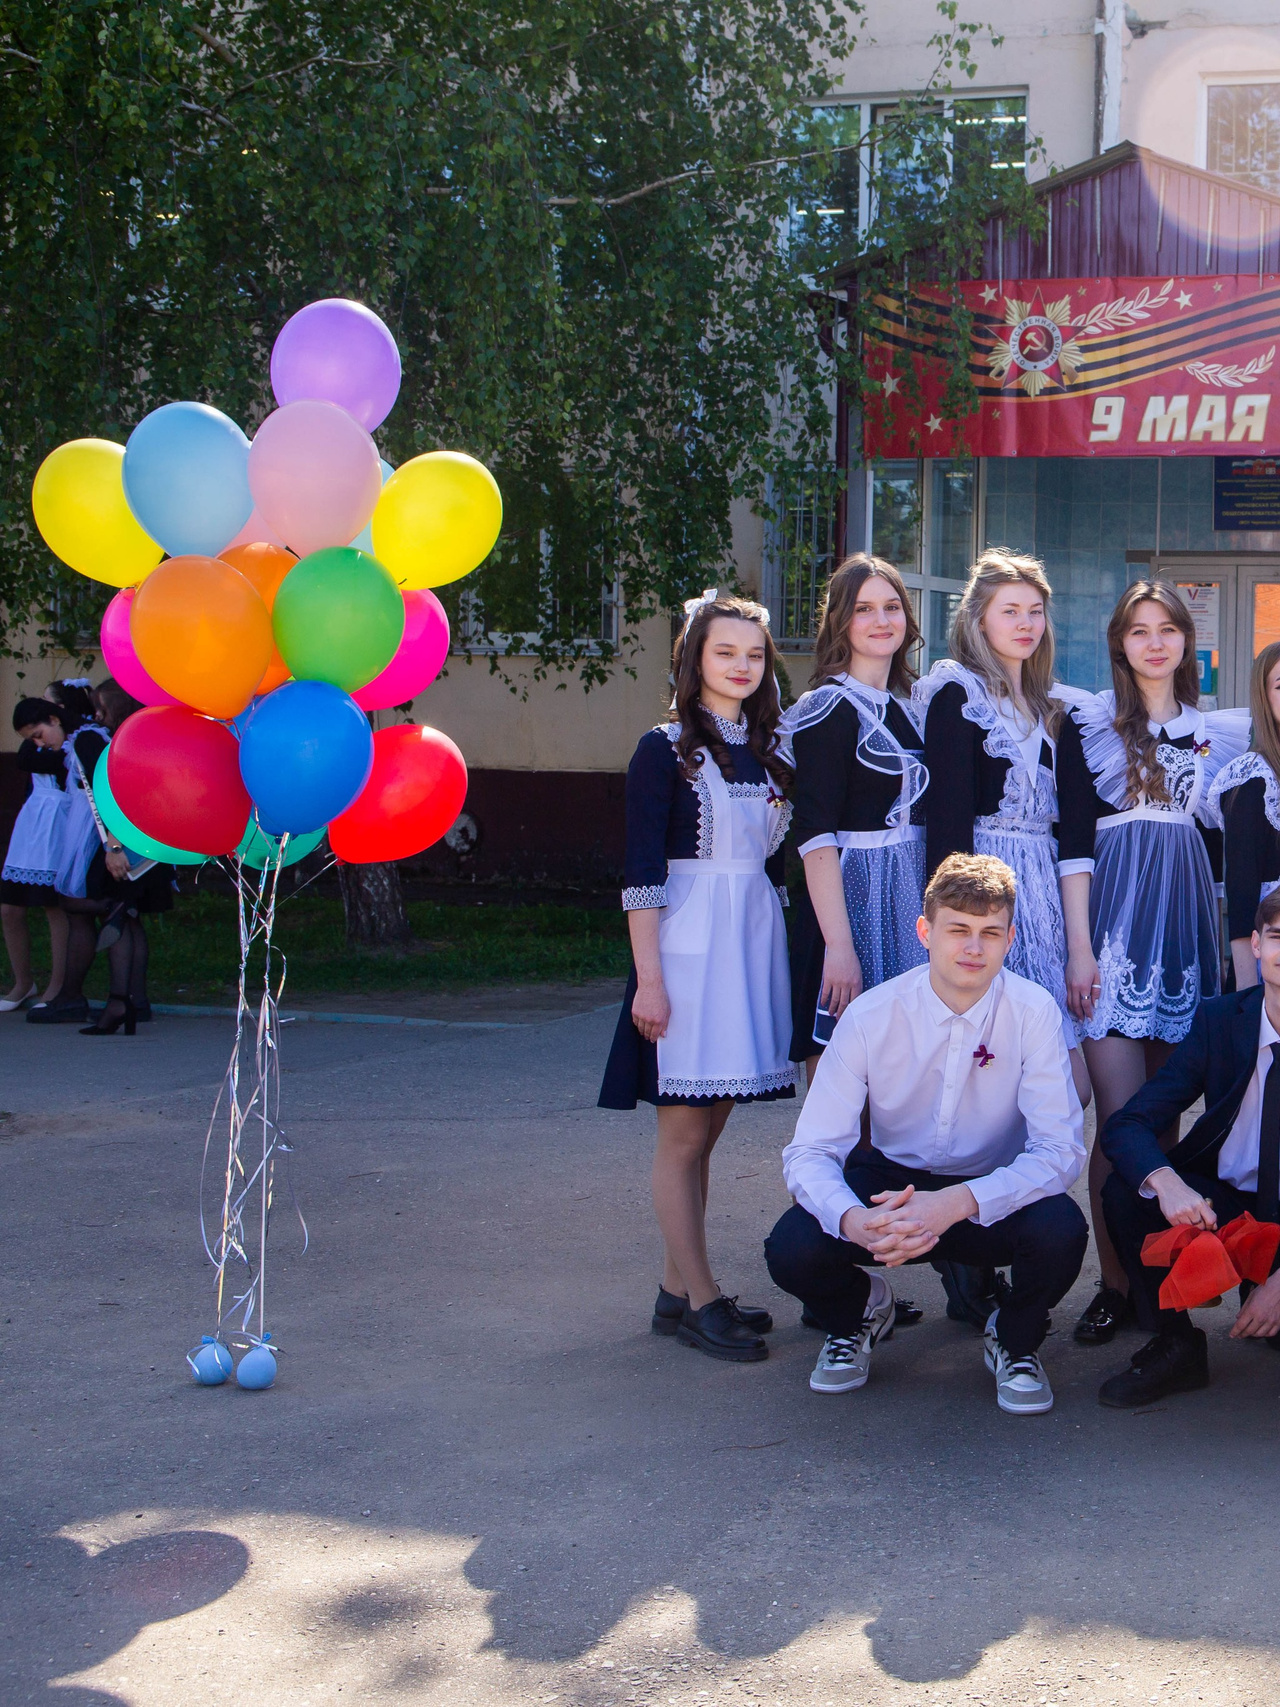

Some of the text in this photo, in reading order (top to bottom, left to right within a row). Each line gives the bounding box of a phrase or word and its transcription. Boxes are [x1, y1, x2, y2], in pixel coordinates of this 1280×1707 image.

[1011, 318, 1057, 366] ОТЕЧЕСТВЕННАЯ
[1089, 394, 1272, 443] 9 МАЯ
